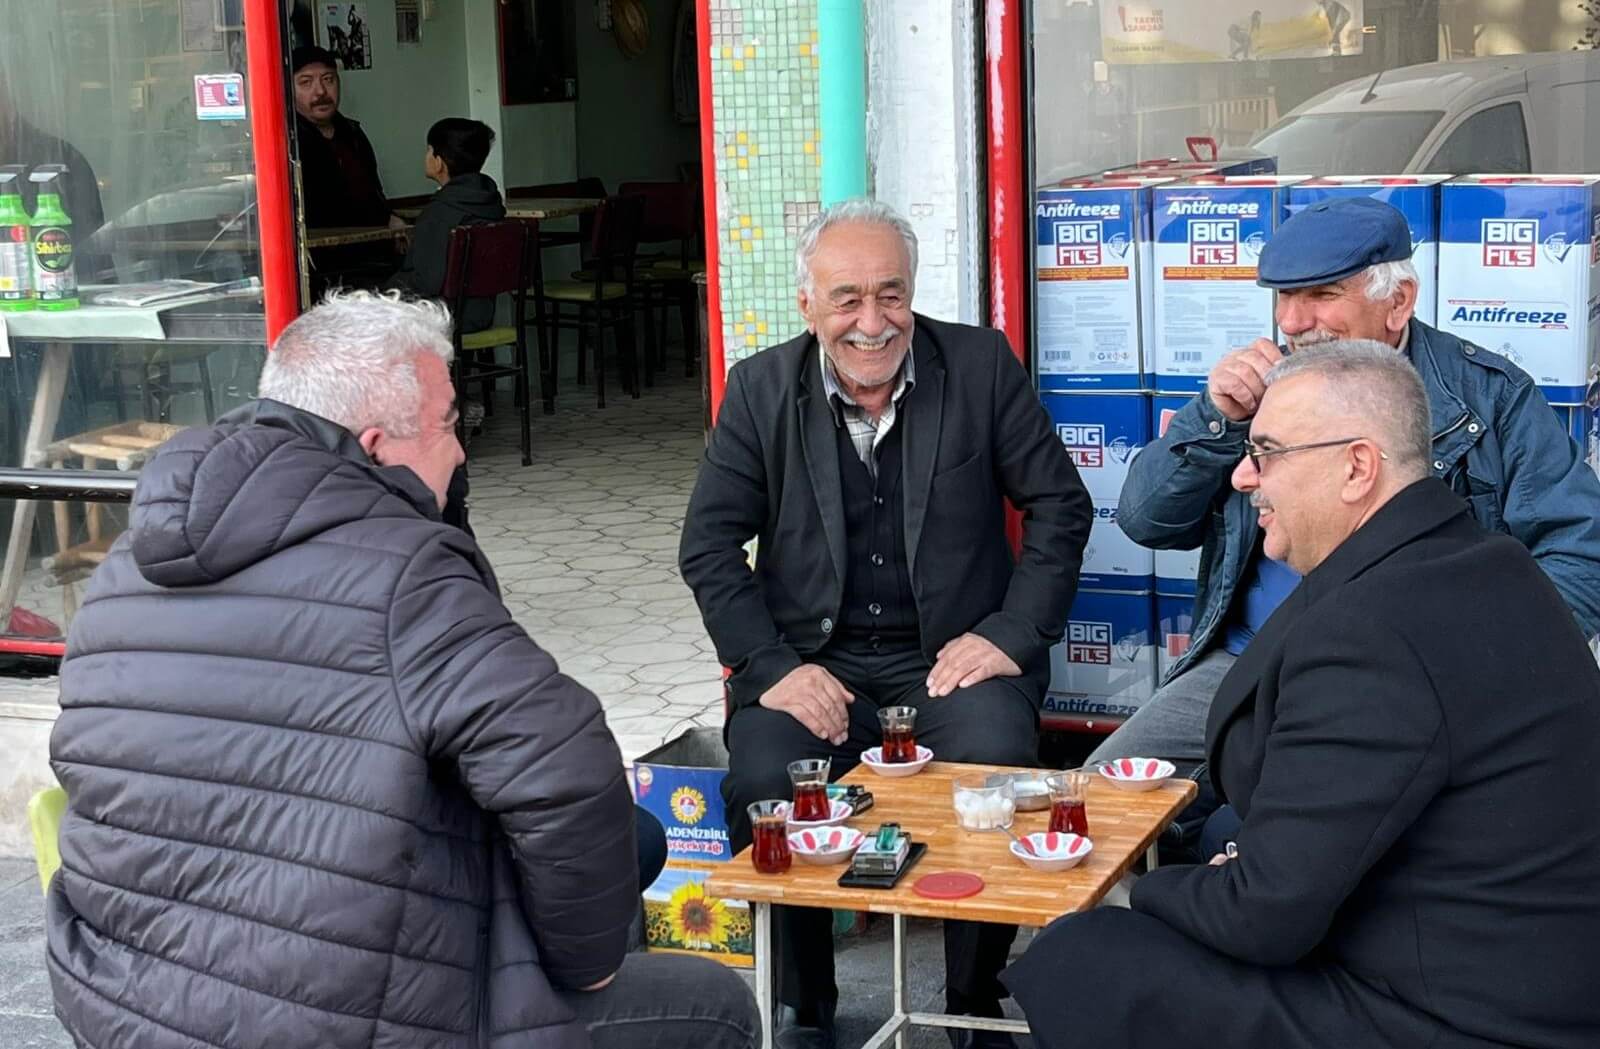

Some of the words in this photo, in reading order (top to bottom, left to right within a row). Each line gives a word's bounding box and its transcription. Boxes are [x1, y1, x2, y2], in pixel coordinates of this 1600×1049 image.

[1036, 203, 1120, 217] Antifreeze
[1167, 200, 1259, 214] Antifreeze
[1058, 224, 1098, 243] BIG
[1193, 223, 1234, 242] BIG
[1487, 222, 1533, 242] BIG
[1452, 306, 1567, 323] Antifreeze
[1061, 426, 1099, 445] BIG
[1069, 623, 1108, 642] BIG
